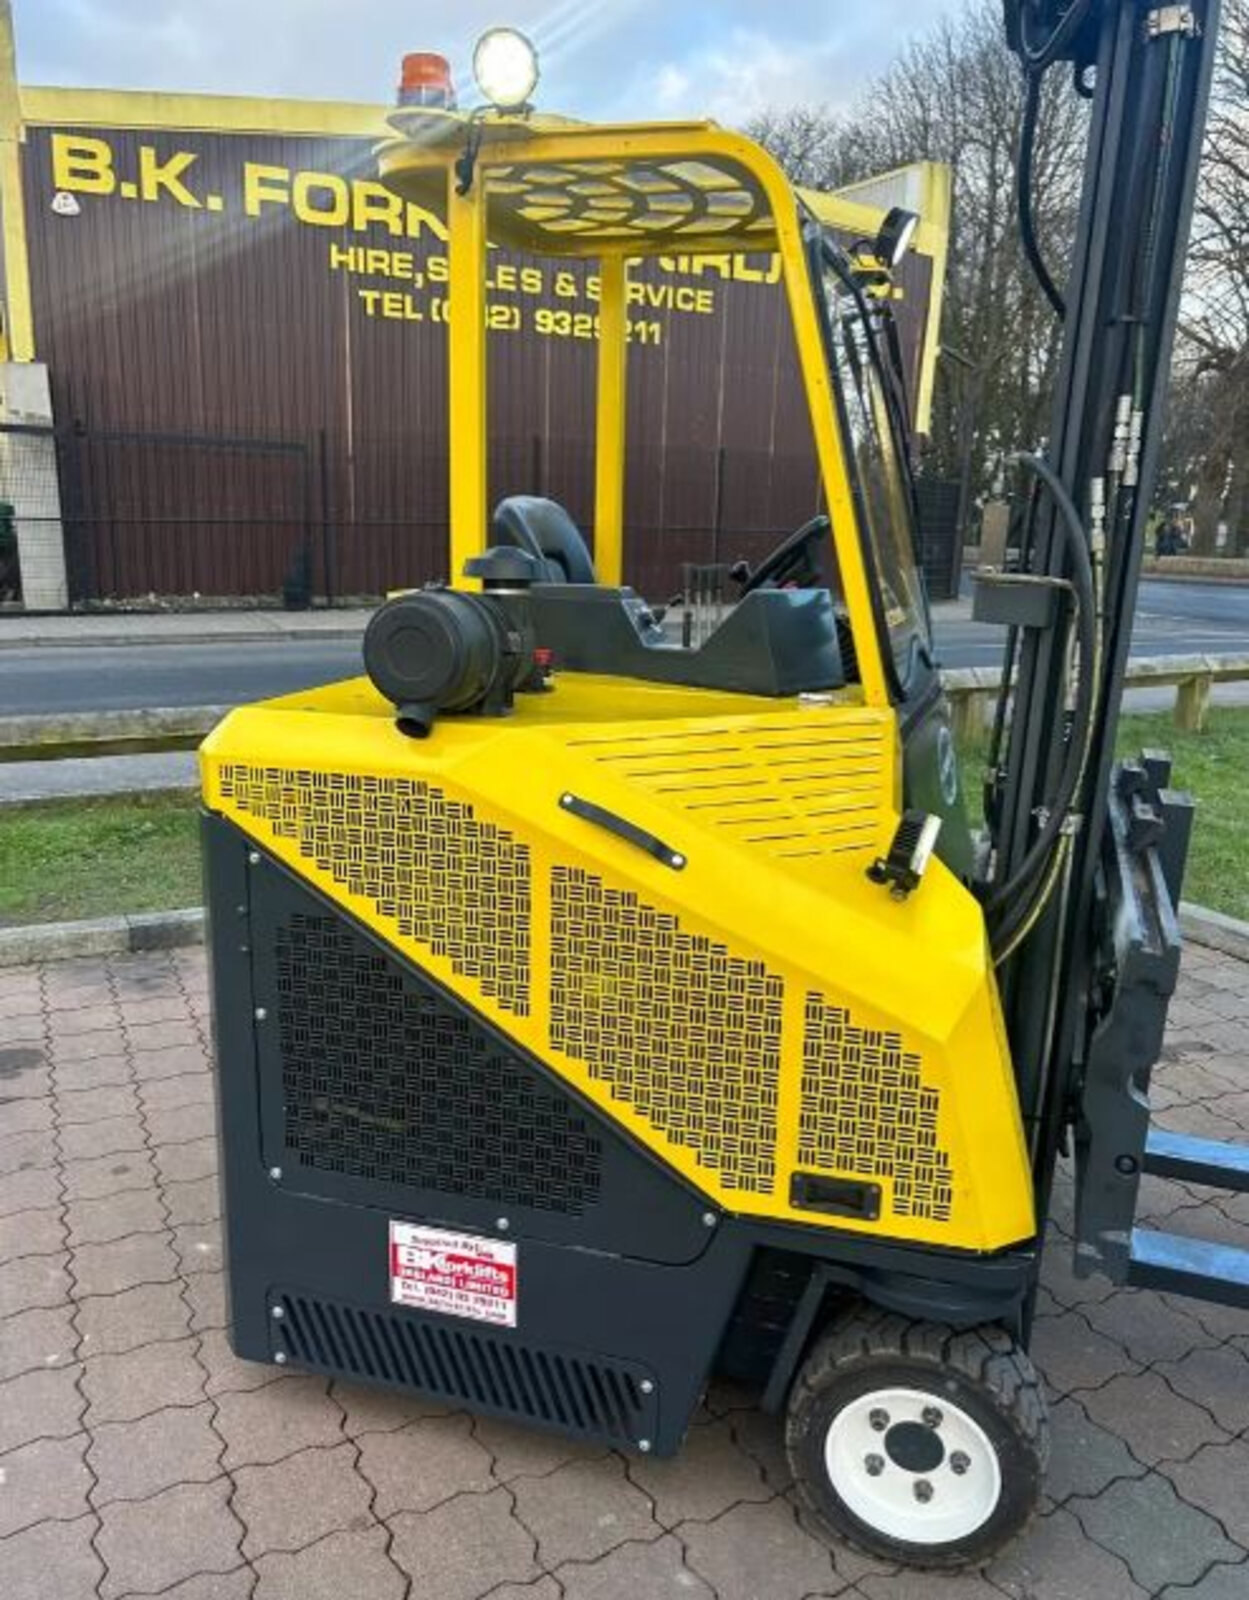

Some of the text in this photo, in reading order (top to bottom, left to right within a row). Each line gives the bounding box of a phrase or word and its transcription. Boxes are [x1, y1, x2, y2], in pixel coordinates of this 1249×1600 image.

[52, 133, 223, 211] B.K.
[359, 290, 661, 345] TEL (2) 93211
[555, 272, 578, 297] &
[586, 276, 714, 314] SRVICE
